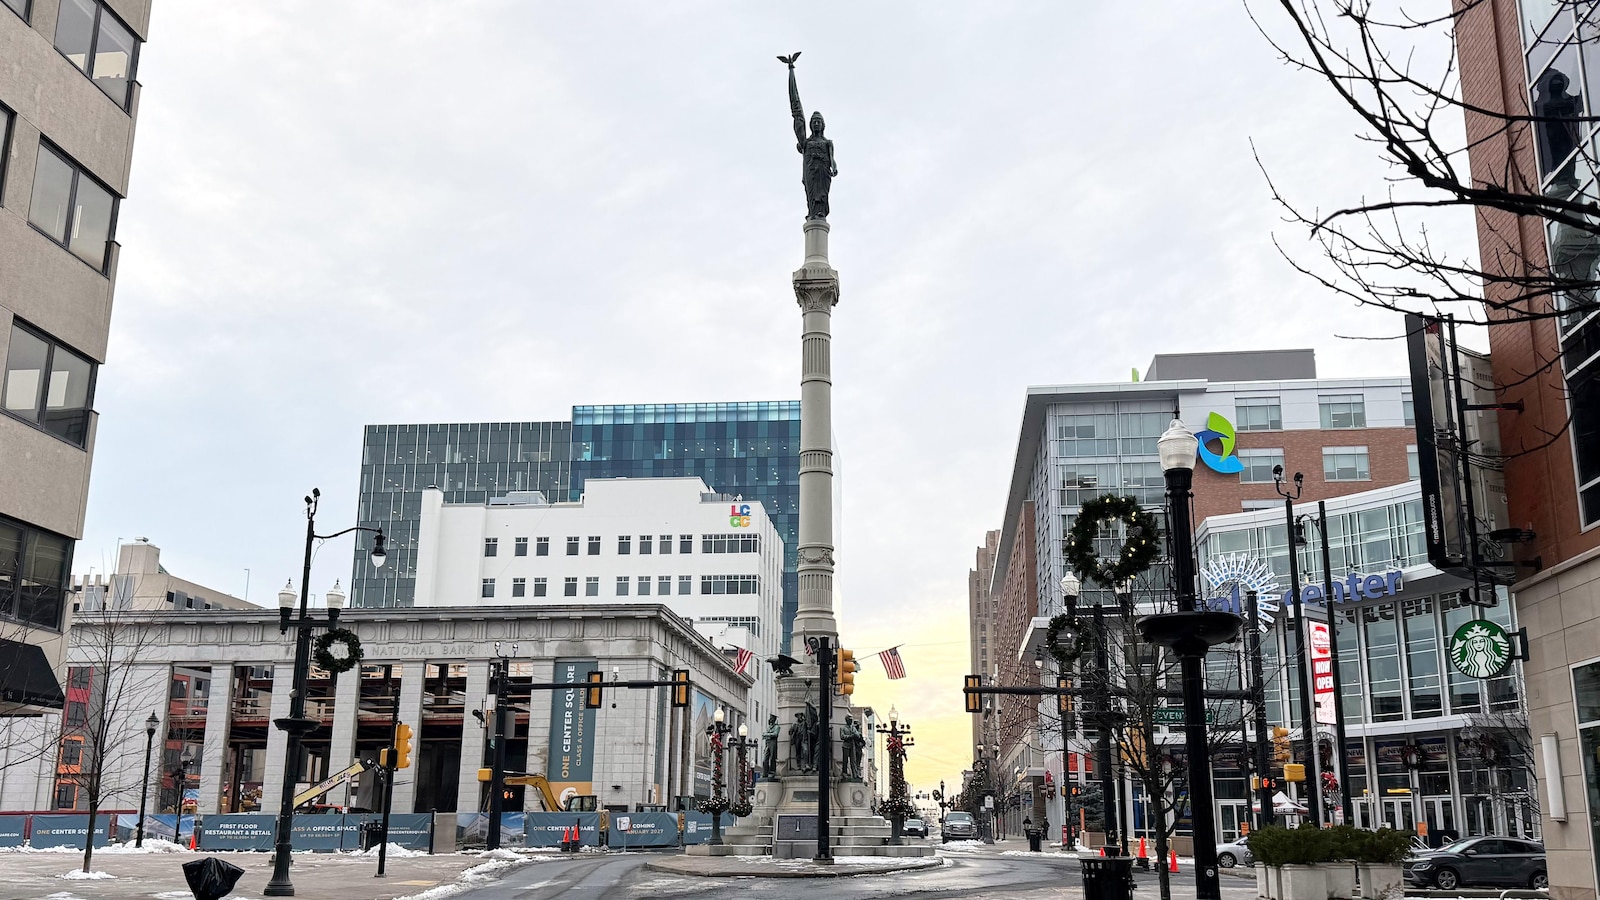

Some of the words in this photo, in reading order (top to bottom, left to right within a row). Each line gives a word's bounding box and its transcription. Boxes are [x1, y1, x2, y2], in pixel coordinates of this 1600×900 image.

[372, 646, 434, 656] NATIONAL
[442, 645, 475, 655] BANK
[1315, 660, 1331, 674] NOW
[1316, 675, 1334, 690] OPEN
[563, 710, 572, 752] CENTER
[575, 745, 583, 767] CLASS
[561, 755, 570, 779] ONE
